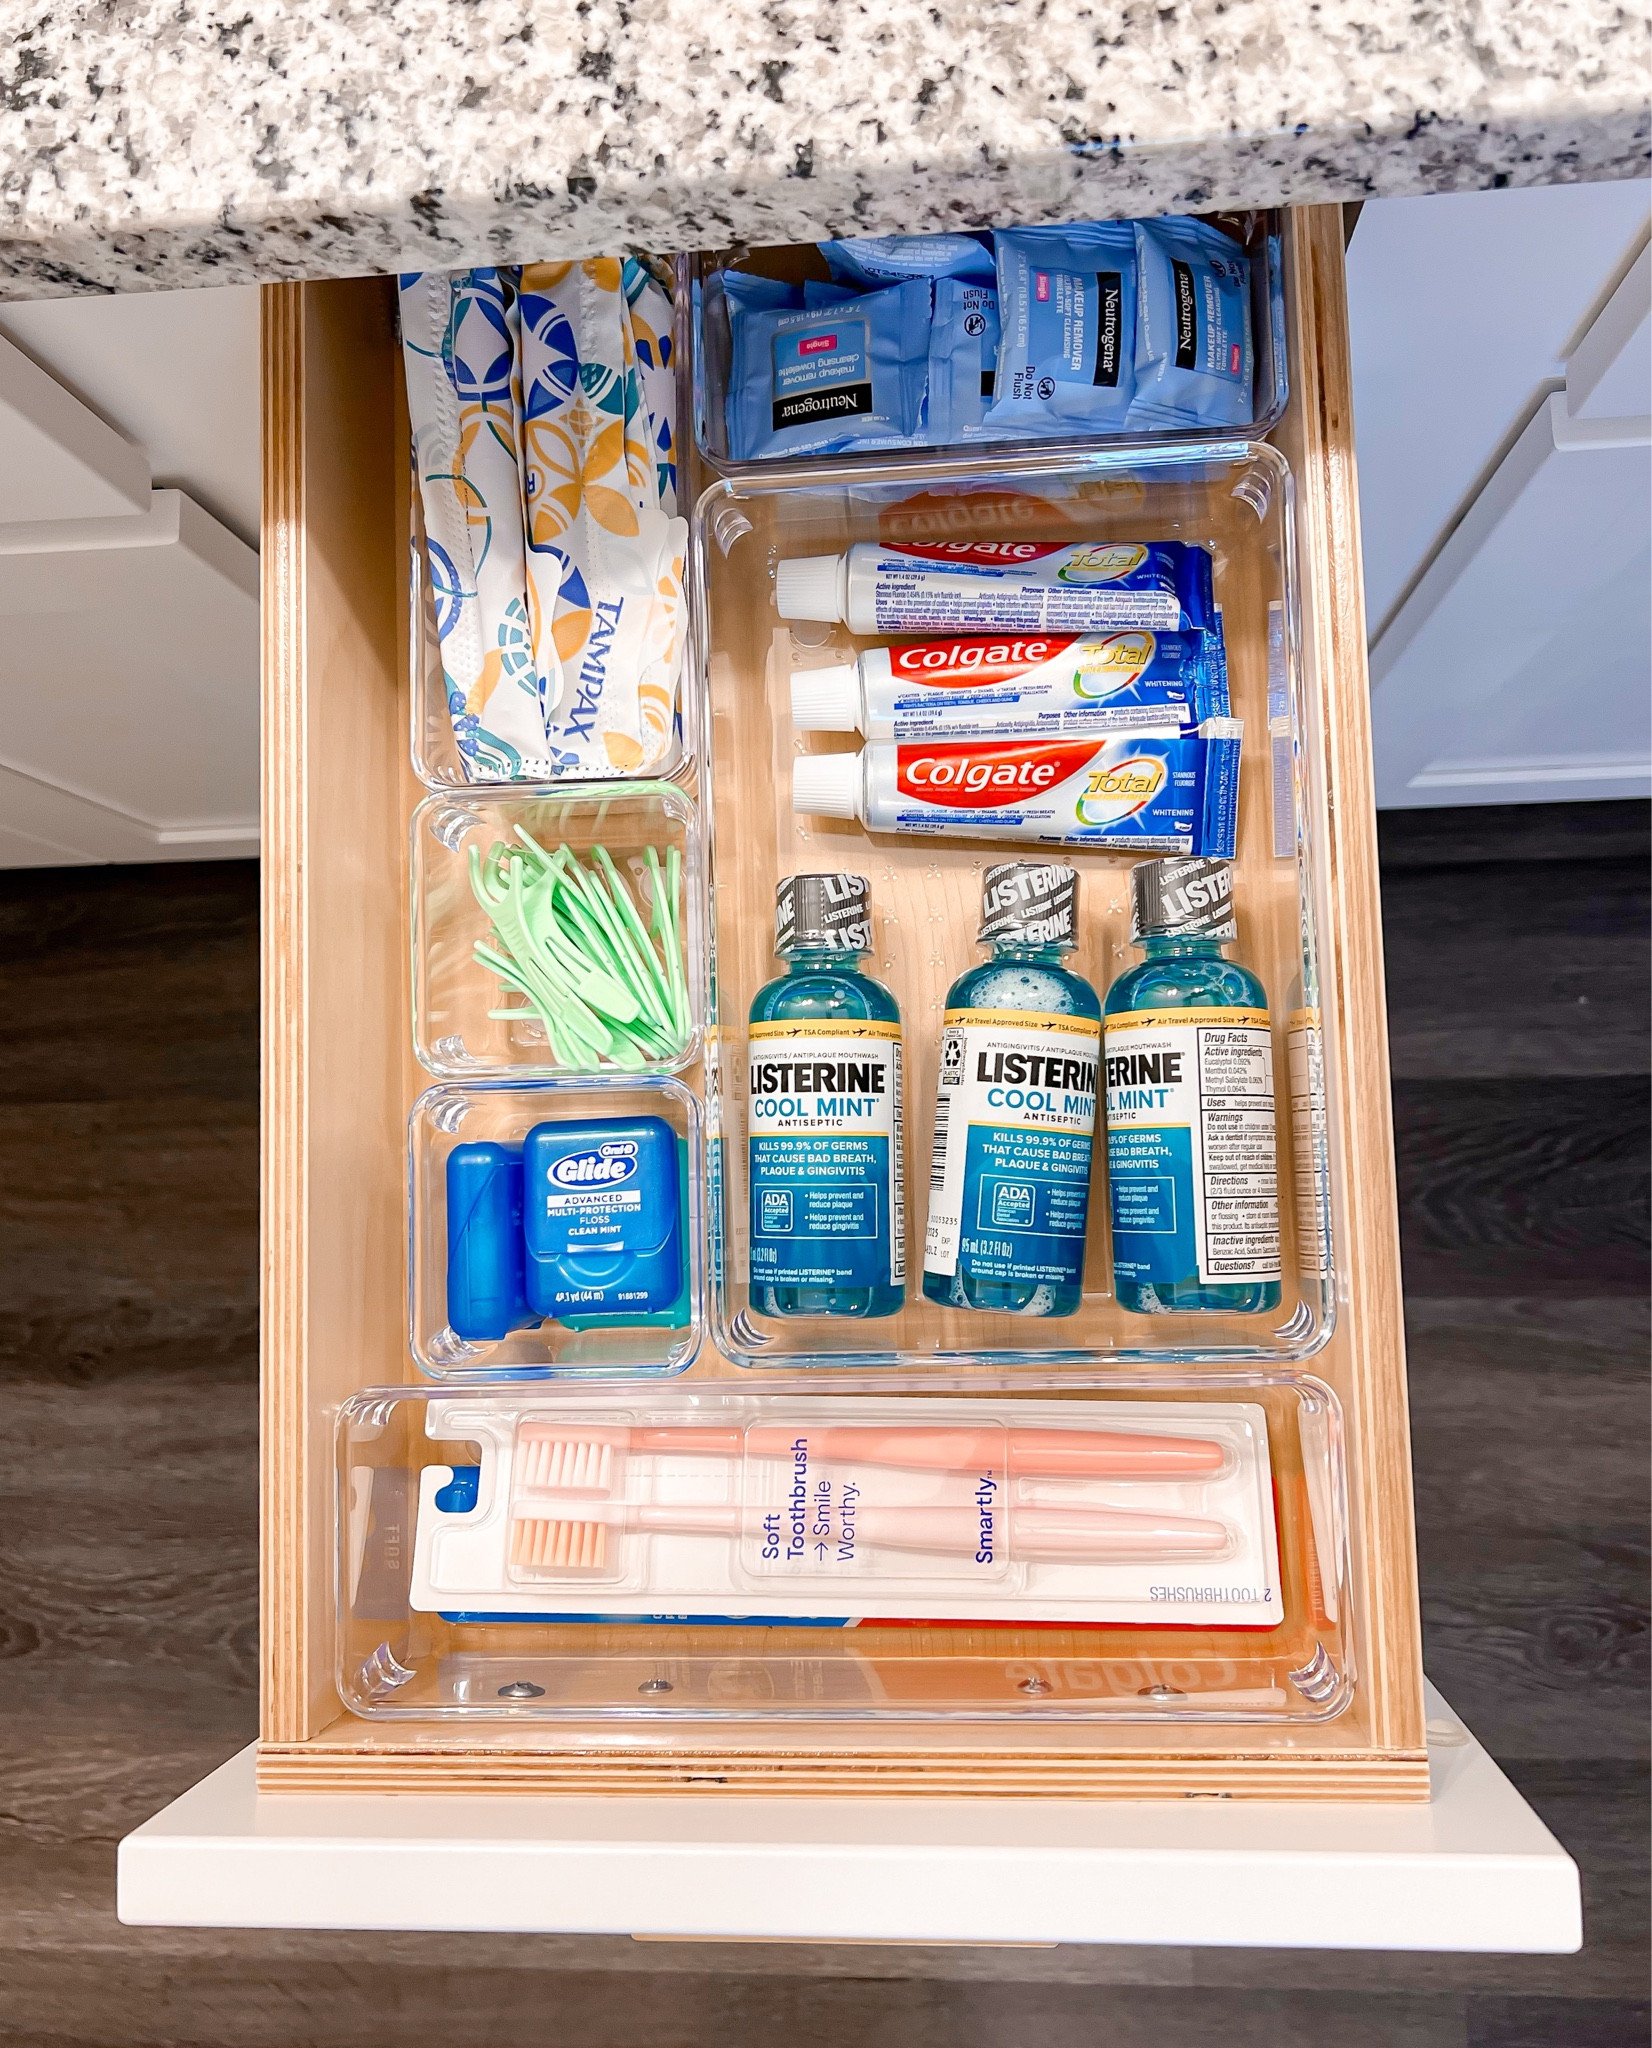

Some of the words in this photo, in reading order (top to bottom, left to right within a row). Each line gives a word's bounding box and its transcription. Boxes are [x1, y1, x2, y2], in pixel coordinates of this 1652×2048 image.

[964, 290, 988, 299] Flush
[1038, 276, 1047, 299] Single
[1056, 274, 1064, 314] TOWELETTE
[1073, 277, 1084, 317] MAKEUP
[1203, 276, 1215, 323] REMOVER
[964, 301, 979, 310] Not
[982, 300, 994, 309] Do
[1180, 273, 1193, 350] Neutrogena
[1101, 288, 1118, 368] Neutrogena
[806, 339, 830, 349] Single
[1070, 318, 1084, 371] REMOVER
[1207, 325, 1215, 368] MAKEUP
[818, 354, 859, 367] cleansing
[778, 360, 816, 376] towelette
[819, 365, 854, 378] makeup
[1025, 366, 1035, 380] Do
[782, 373, 816, 386] remover
[1013, 372, 1024, 400] Flush
[1023, 382, 1034, 400] Not
[784, 393, 858, 413] Neutrogena
[1069, 550, 1145, 567] Total
[900, 642, 1048, 672] Colgate
[1081, 643, 1152, 665] Total
[563, 596, 624, 743] TAMPAX
[906, 758, 1055, 793] Colgate
[1088, 771, 1162, 793] Total
[1160, 859, 1207, 886] LISTERINE
[983, 865, 1075, 918] LISTERINE
[824, 903, 864, 924] LISTERINE
[992, 1019, 1024, 1027] Approved
[1024, 1020, 1038, 1028] Size
[1070, 1025, 1092, 1034] Compliant
[1204, 1032, 1225, 1044] Drug
[1228, 1033, 1248, 1043] Facts
[987, 1042, 1040, 1051] ANTIGINGIVITIS
[1046, 1046, 1083, 1056] ANTIPLAQUE
[1131, 1042, 1172, 1050] MOUTHWASH
[1204, 1047, 1228, 1056] Active
[1231, 1047, 1262, 1057] ingredients
[753, 1053, 788, 1061] ANTIGINGIVITIS
[751, 1063, 885, 1095] LISTERINE
[1206, 1086, 1226, 1094] Thymol
[987, 1088, 1057, 1112] COOL
[1119, 1089, 1168, 1110] MINT
[755, 1098, 808, 1118] COOL
[817, 1098, 875, 1117] MINT
[778, 1119, 843, 1127] ANTISEPTIC
[1024, 1112, 1081, 1125] ANTISEPTIC
[1208, 1113, 1243, 1123] Warnings
[993, 1132, 1023, 1144] KILLS
[1026, 1135, 1056, 1147] 99.9%
[1058, 1139, 1071, 1147] OF
[1072, 1140, 1091, 1150] GERMS
[1129, 1134, 1161, 1143] GERMS
[759, 1142, 779, 1150] KILLS
[781, 1142, 811, 1150] 99.9%
[813, 1142, 828, 1150] OF
[831, 1142, 868, 1150] GERMS
[1116, 1148, 1130, 1156] BAD
[1131, 1147, 1172, 1156] BREATH,
[755, 1154, 770, 1163] THAT
[772, 1154, 805, 1163] CAUSE
[808, 1154, 831, 1163] BAD
[834, 1154, 877, 1164] BREATH,
[1116, 1160, 1160, 1169] GINGIVITIS
[556, 1157, 627, 1183] Glide
[761, 1167, 796, 1176] PLAQUE
[798, 1167, 804, 1175] &
[807, 1167, 865, 1175] GINGIVITIS
[995, 1158, 1040, 1171] PLAQUE
[1042, 1162, 1049, 1171] &
[1051, 1164, 1088, 1175] GINGIVITIS
[1210, 1176, 1248, 1186] Directions
[564, 1194, 623, 1205] ADVANCED
[765, 1194, 788, 1206] ADA
[809, 1192, 827, 1200] Helps
[828, 1192, 851, 1200] prevent
[999, 1186, 1030, 1200] ADA
[547, 1203, 641, 1216] MULTI-PROTECTION
[832, 1201, 853, 1209] plaque
[998, 1200, 1030, 1209] Accepted
[1212, 1200, 1232, 1210] Other
[1235, 1200, 1268, 1209] information
[579, 1216, 610, 1224] FLOSS
[832, 1223, 859, 1231] gingivitis
[568, 1227, 598, 1235] CLEAN
[600, 1226, 622, 1234] MINT
[1213, 1236, 1244, 1245] Inactive
[1246, 1236, 1274, 1245] ingredients
[970, 1240, 979, 1254] mL
[980, 1239, 993, 1256] (3.2
[1002, 1243, 1013, 1259] Oz)
[1214, 1261, 1255, 1271] Questions?
[570, 1292, 580, 1303] yd
[581, 1292, 592, 1301] (44
[593, 1290, 604, 1301] m)
[787, 1439, 807, 1560] Toothbrush
[813, 1480, 831, 1536] Smile
[837, 1482, 860, 1561] Worthy.
[762, 1513, 781, 1560] Soft
[1149, 1586, 1260, 1604] TOOTHBRUSHES
[1264, 1588, 1272, 1602] 2
